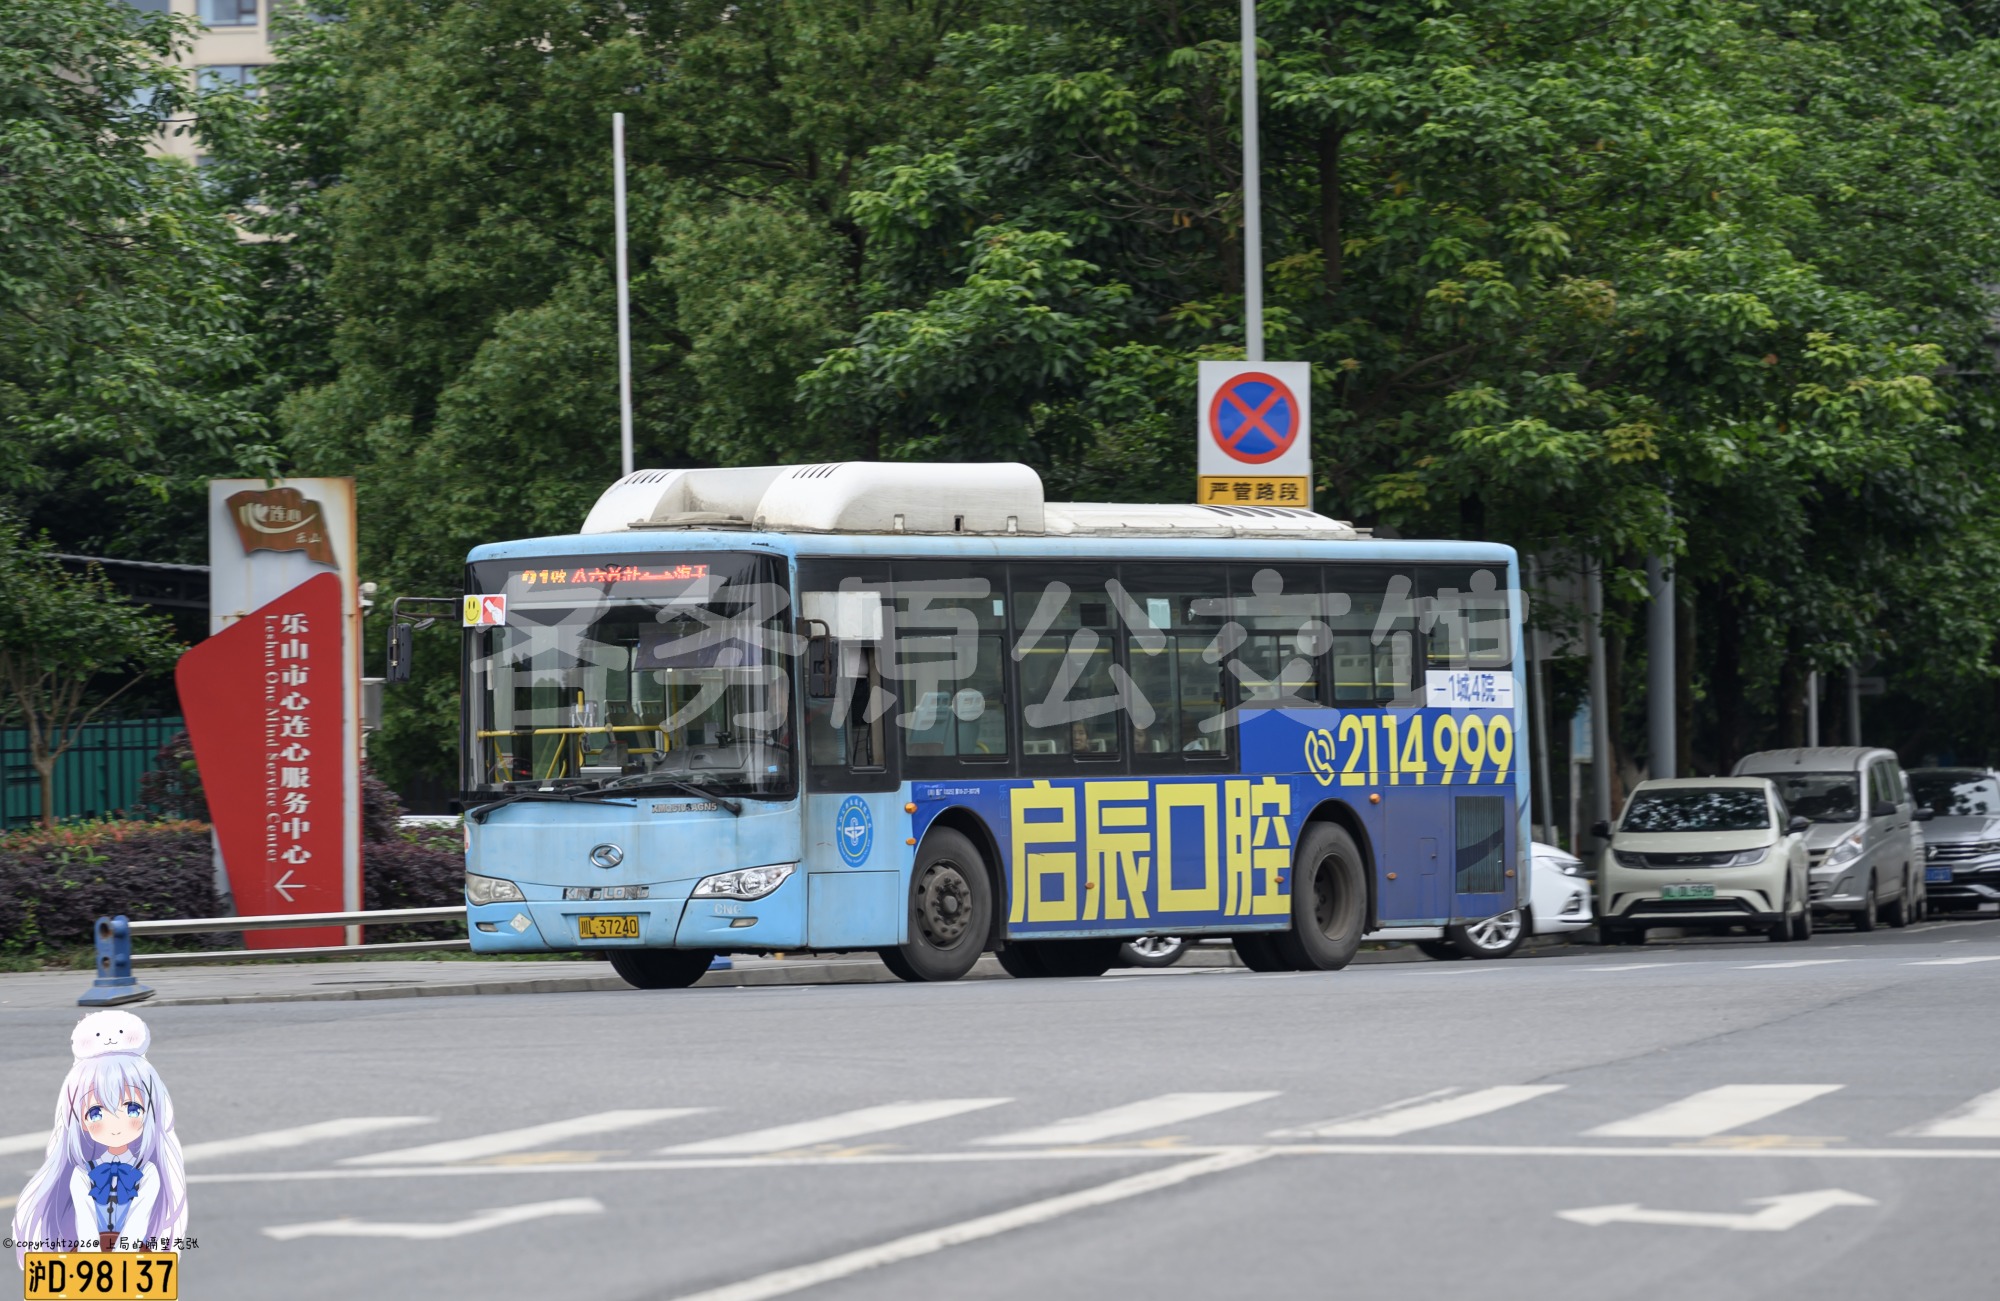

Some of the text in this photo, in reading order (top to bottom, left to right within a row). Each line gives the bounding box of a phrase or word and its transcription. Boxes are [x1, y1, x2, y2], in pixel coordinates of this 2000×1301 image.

[1208, 482, 1300, 501] 严管路段
[265, 615, 282, 863] Leshan One Mind Service Center
[280, 613, 313, 865] 乐山市心连心服务中心
[1338, 713, 1514, 786] 2114999
[1008, 776, 1292, 924] 启辰口腔
